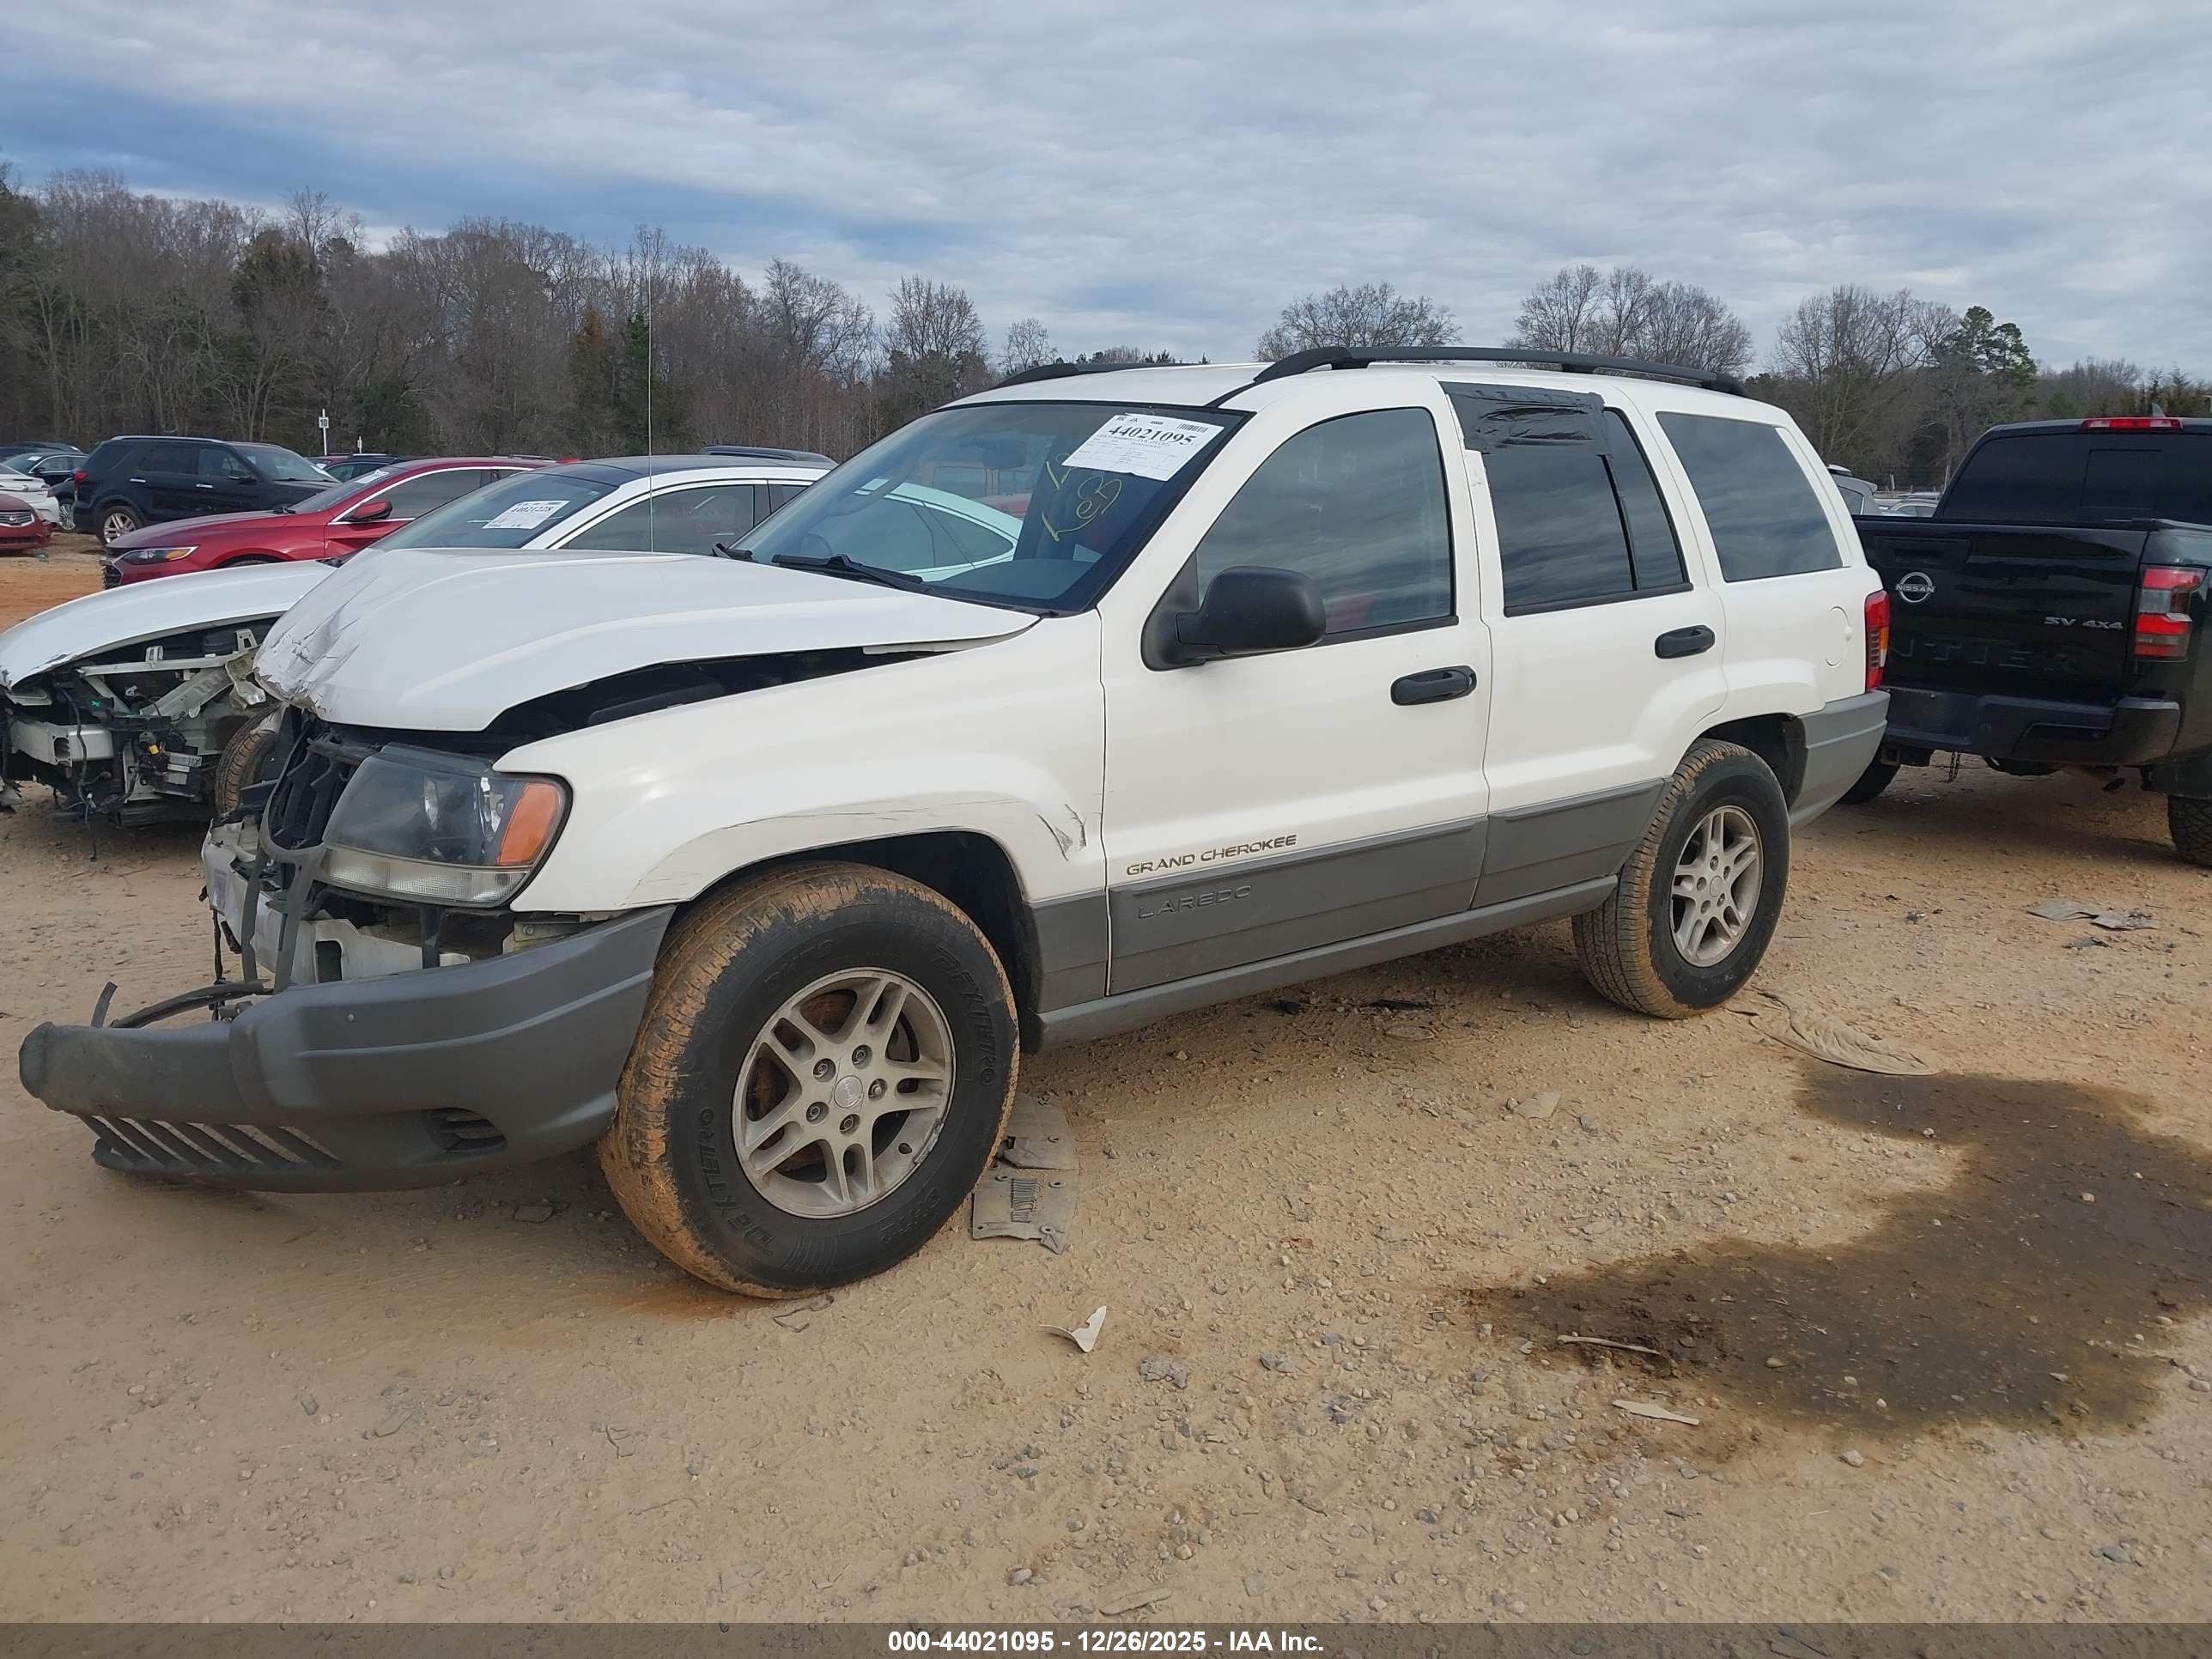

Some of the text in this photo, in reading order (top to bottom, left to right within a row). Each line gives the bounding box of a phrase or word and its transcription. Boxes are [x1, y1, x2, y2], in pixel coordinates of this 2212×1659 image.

[1108, 424, 1199, 447] 44021095
[1895, 583, 1936, 593] NISSAN
[2043, 616, 2076, 627] SV
[1126, 834, 1298, 876] GRAND CHEROKEE
[1137, 884, 1253, 921] LAREDO
